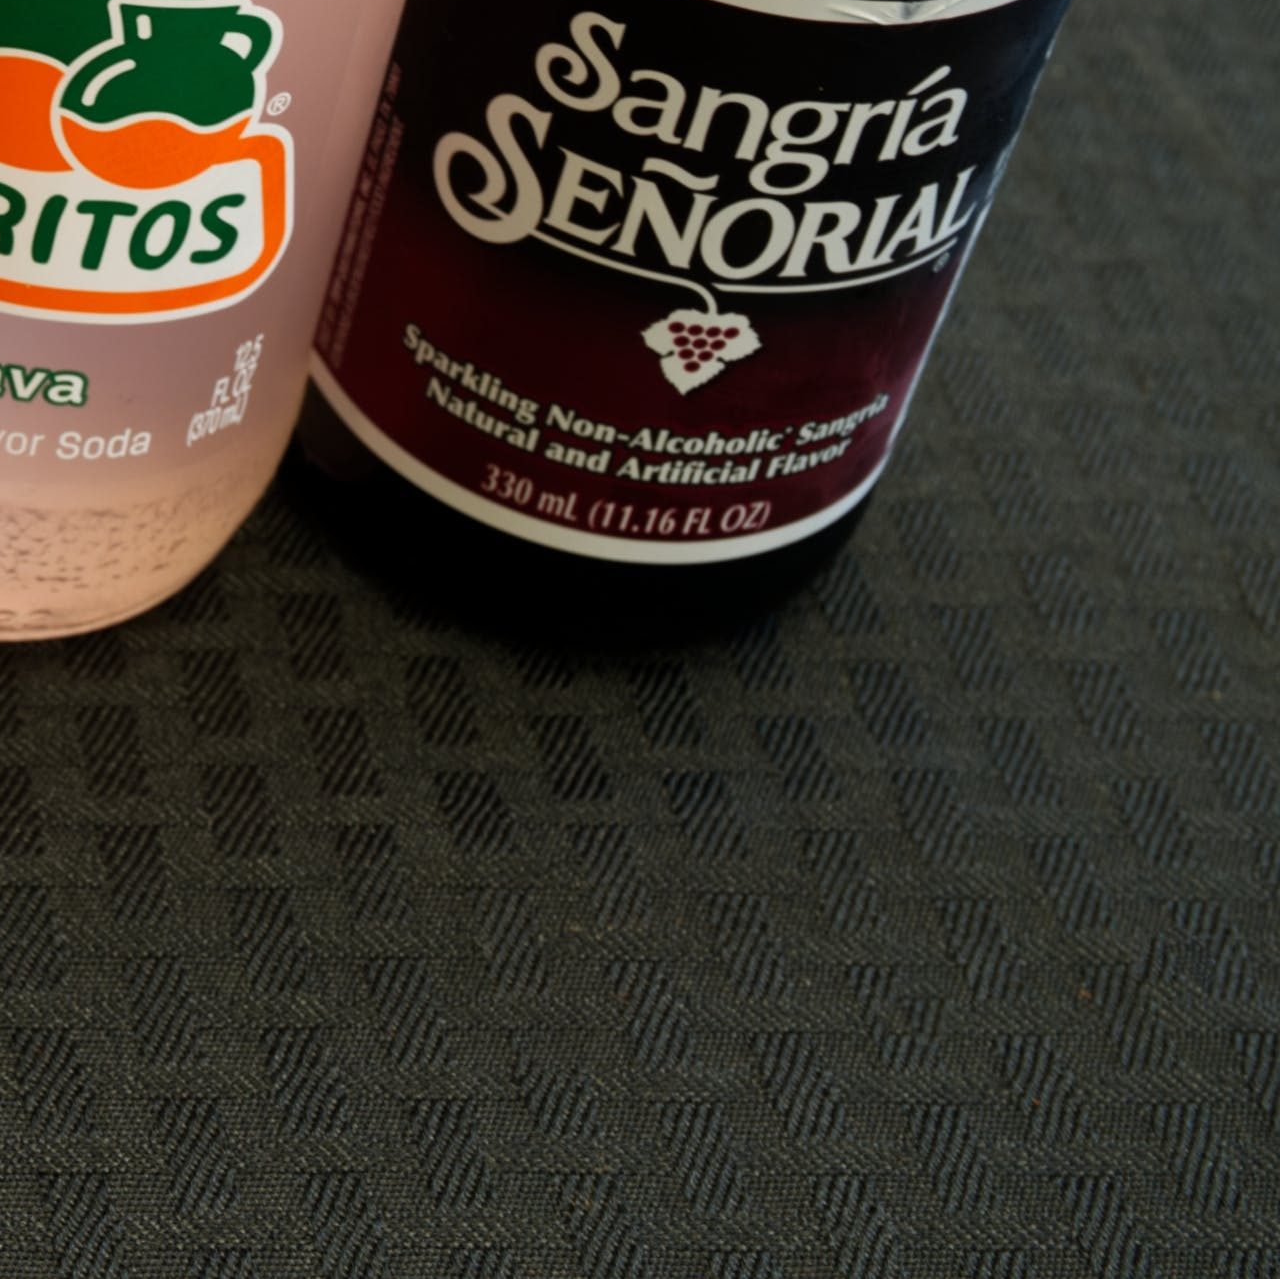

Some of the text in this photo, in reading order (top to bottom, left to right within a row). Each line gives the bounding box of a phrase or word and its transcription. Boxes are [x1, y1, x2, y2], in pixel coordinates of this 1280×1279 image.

[534, 11, 969, 196] Sangría
[432, 93, 978, 281] SEÑORIAL
[402, 323, 540, 425] Sparkling
[55, 428, 153, 460] Soda
[426, 375, 853, 485] Natural and Artificial Flavor
[480, 463, 772, 536] 330 mL (11.16 FL OZ)
